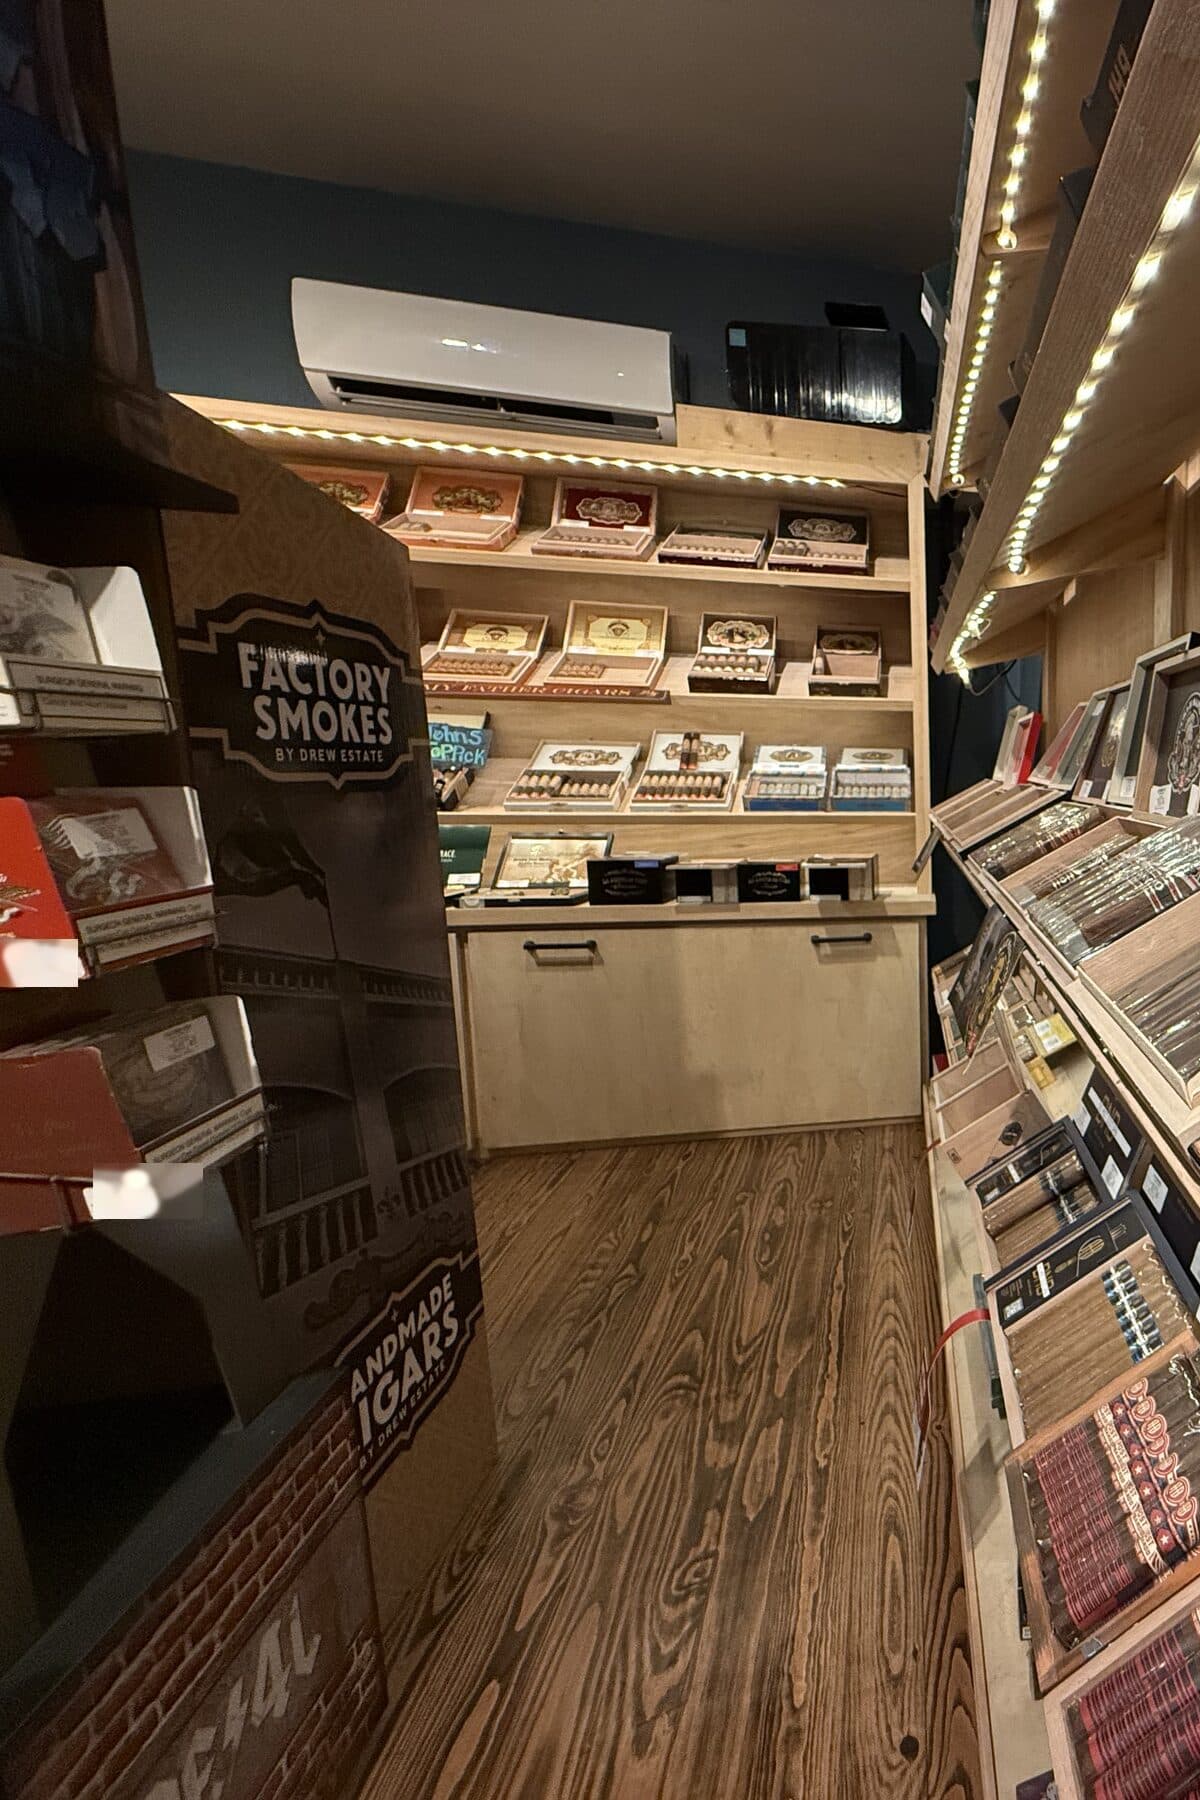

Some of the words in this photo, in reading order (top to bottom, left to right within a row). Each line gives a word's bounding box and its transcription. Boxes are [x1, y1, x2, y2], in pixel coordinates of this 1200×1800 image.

[237, 642, 390, 704] FACTORY
[551, 686, 631, 697] CIGARS
[254, 695, 393, 745] SMOKES
[275, 748, 294, 762] BY
[300, 748, 336, 762] DREW
[341, 750, 384, 763] ESTATE
[351, 1272, 453, 1403] ANDMADE
[358, 1301, 459, 1448] IGARS
[359, 1449, 374, 1470] BY
[378, 1403, 408, 1448] DREW
[410, 1360, 446, 1408] ESTATE
